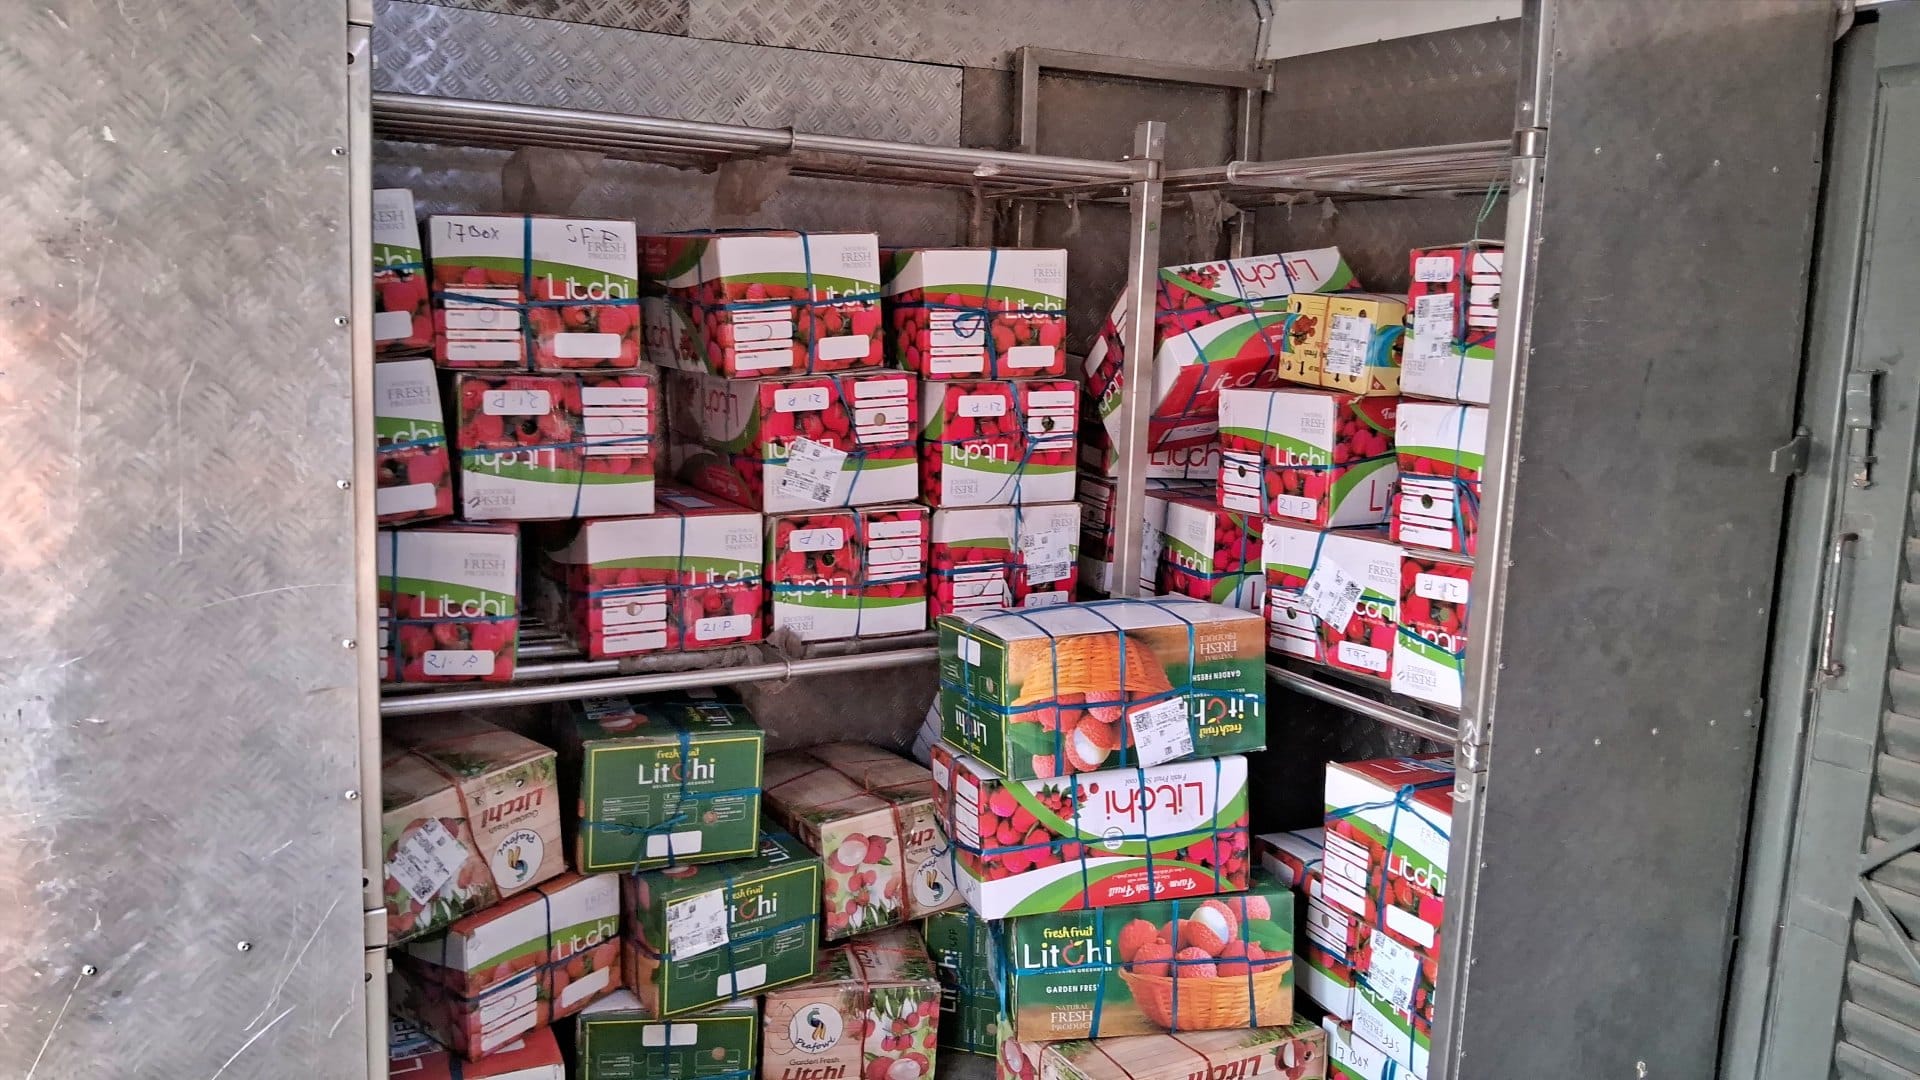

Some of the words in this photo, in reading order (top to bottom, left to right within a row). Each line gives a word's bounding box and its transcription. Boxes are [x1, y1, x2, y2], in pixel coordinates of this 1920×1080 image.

[841, 252, 872, 262] FRESH
[1237, 258, 1319, 289] Litchi
[548, 273, 629, 301] Litchi
[1005, 296, 1063, 319] Litchi
[473, 447, 556, 474] Litchi
[950, 443, 1008, 467] Litchi
[1276, 442, 1327, 467] Litchi
[464, 558, 506, 570] FRESH
[690, 562, 760, 591] Litchi
[420, 591, 506, 618] Litchi
[1200, 641, 1238, 655] FRESH
[1192, 673, 1213, 682] FRESH
[1213, 670, 1242, 679] GARDEN
[1105, 781, 1204, 823] Litchi
[1169, 878, 1197, 891] Farm
[1388, 855, 1447, 897] Litchi
[1108, 884, 1135, 898] Fruit
[556, 919, 617, 960] Litchi
[1043, 926, 1069, 939] fresh
[1070, 925, 1093, 938] fruit
[1046, 985, 1078, 994] GARDEN
[1079, 983, 1100, 992] FRES
[1051, 1010, 1094, 1023] FRESH
[789, 1058, 818, 1066] Garden
[819, 1056, 841, 1065] Fresh
